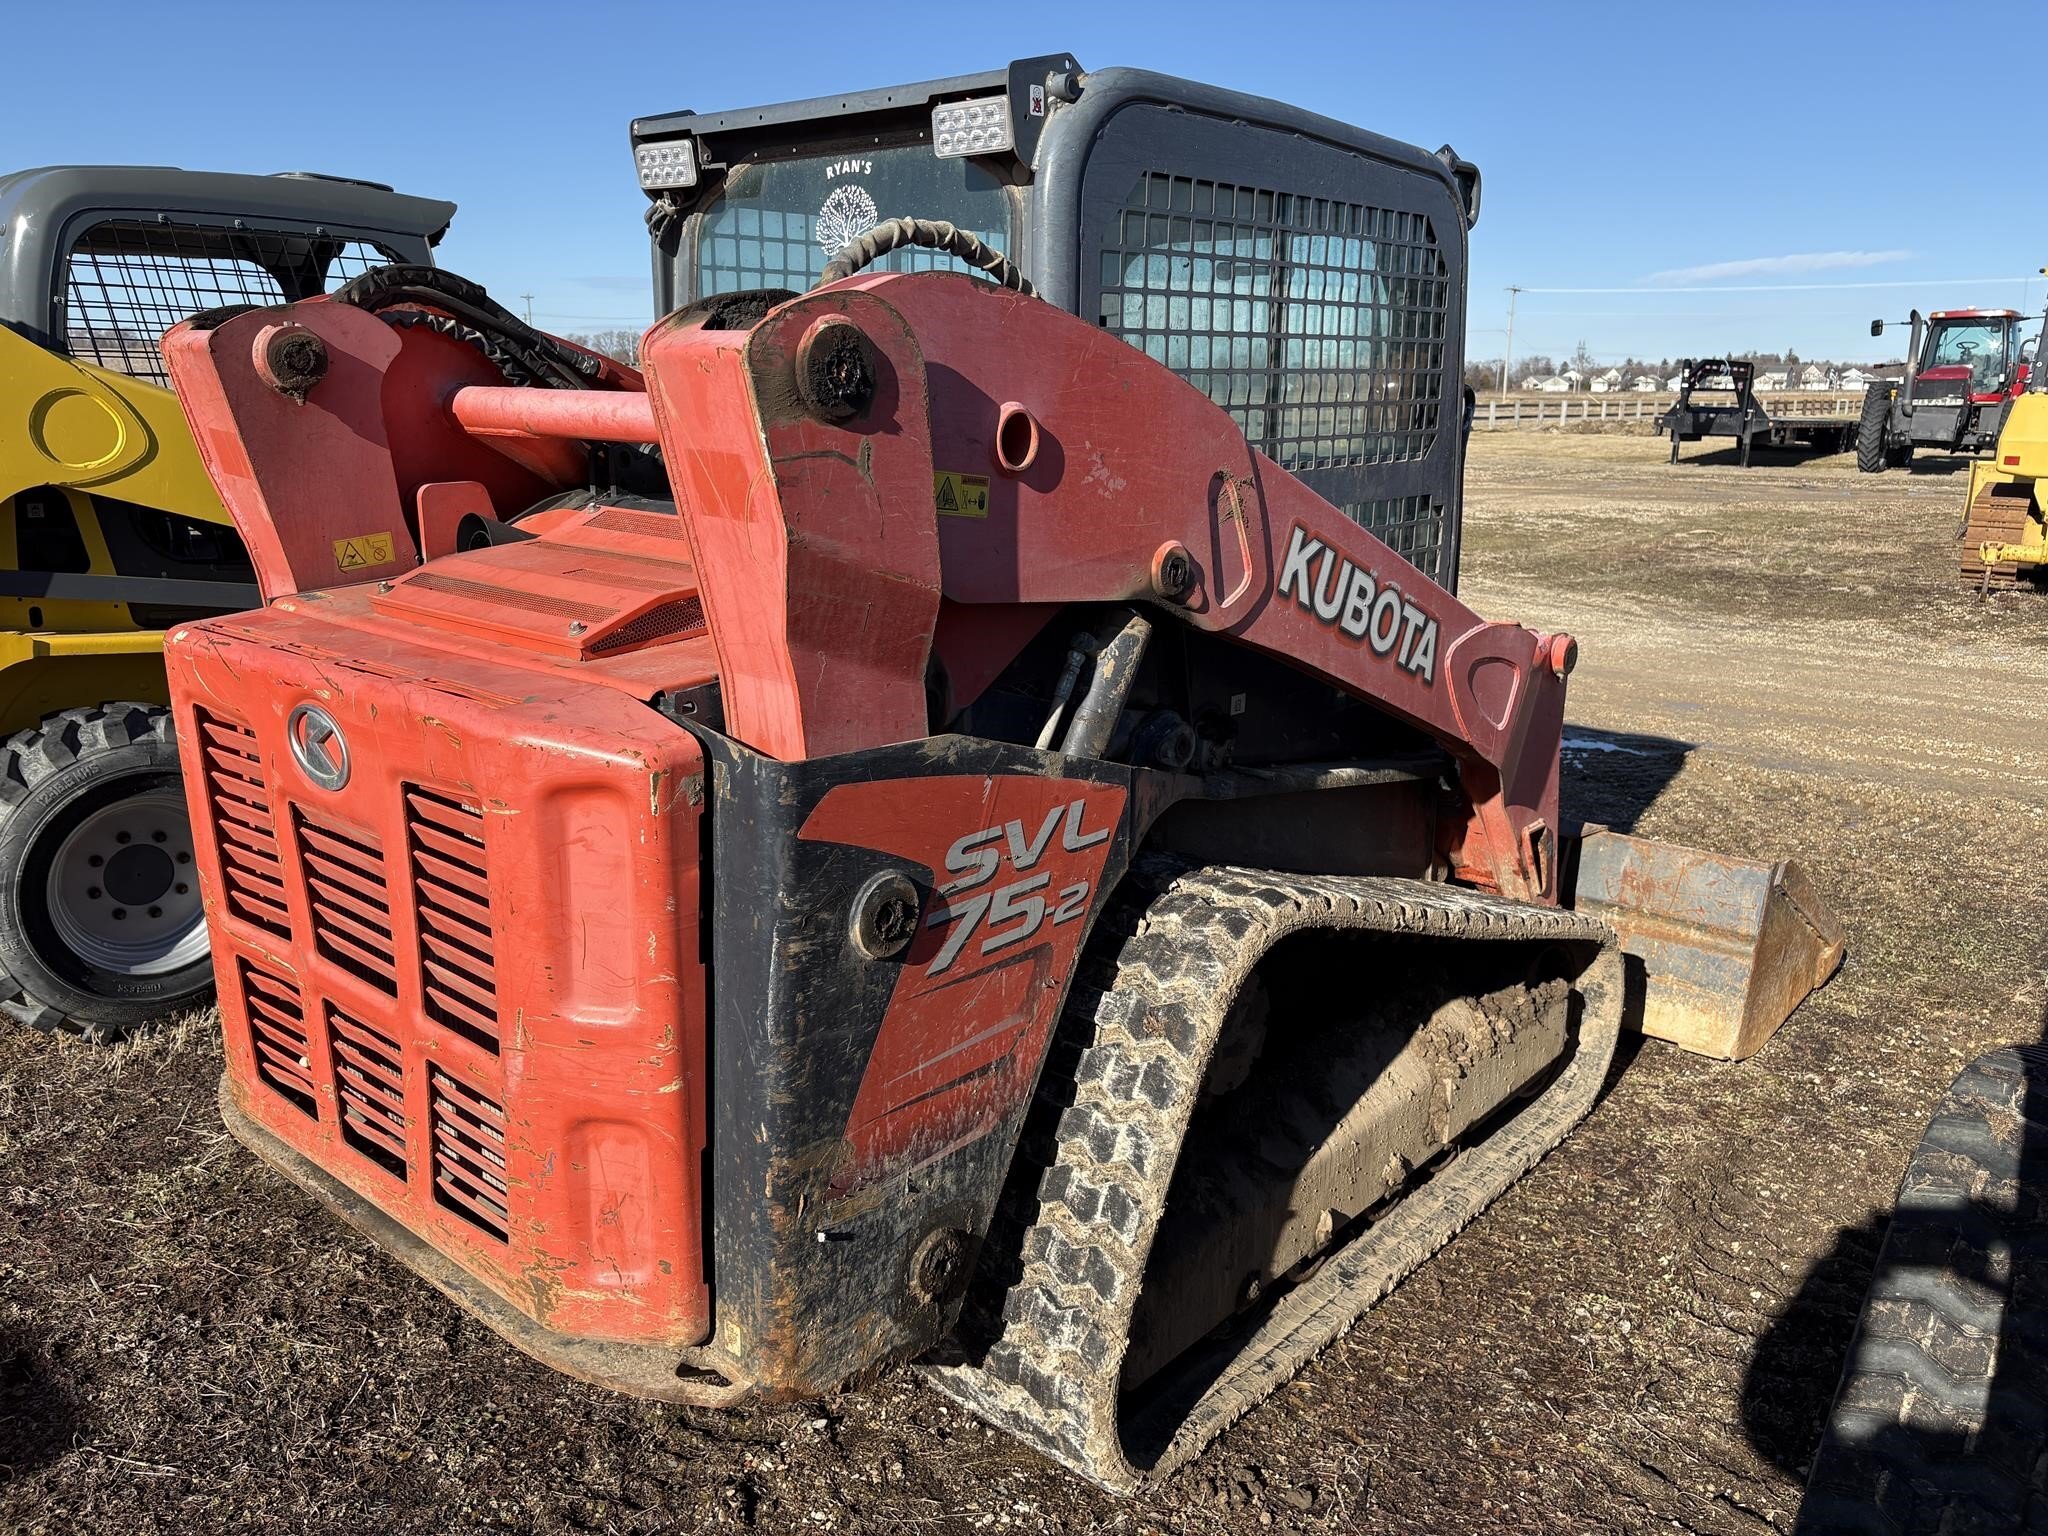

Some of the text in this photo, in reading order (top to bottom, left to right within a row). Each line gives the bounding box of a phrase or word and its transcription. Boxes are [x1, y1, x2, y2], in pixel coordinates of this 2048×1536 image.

[826, 160, 872, 179] RYAN'S
[1278, 526, 1439, 684] KUBOTA
[937, 799, 1110, 898] SVL
[925, 870, 1090, 979] 75-2
